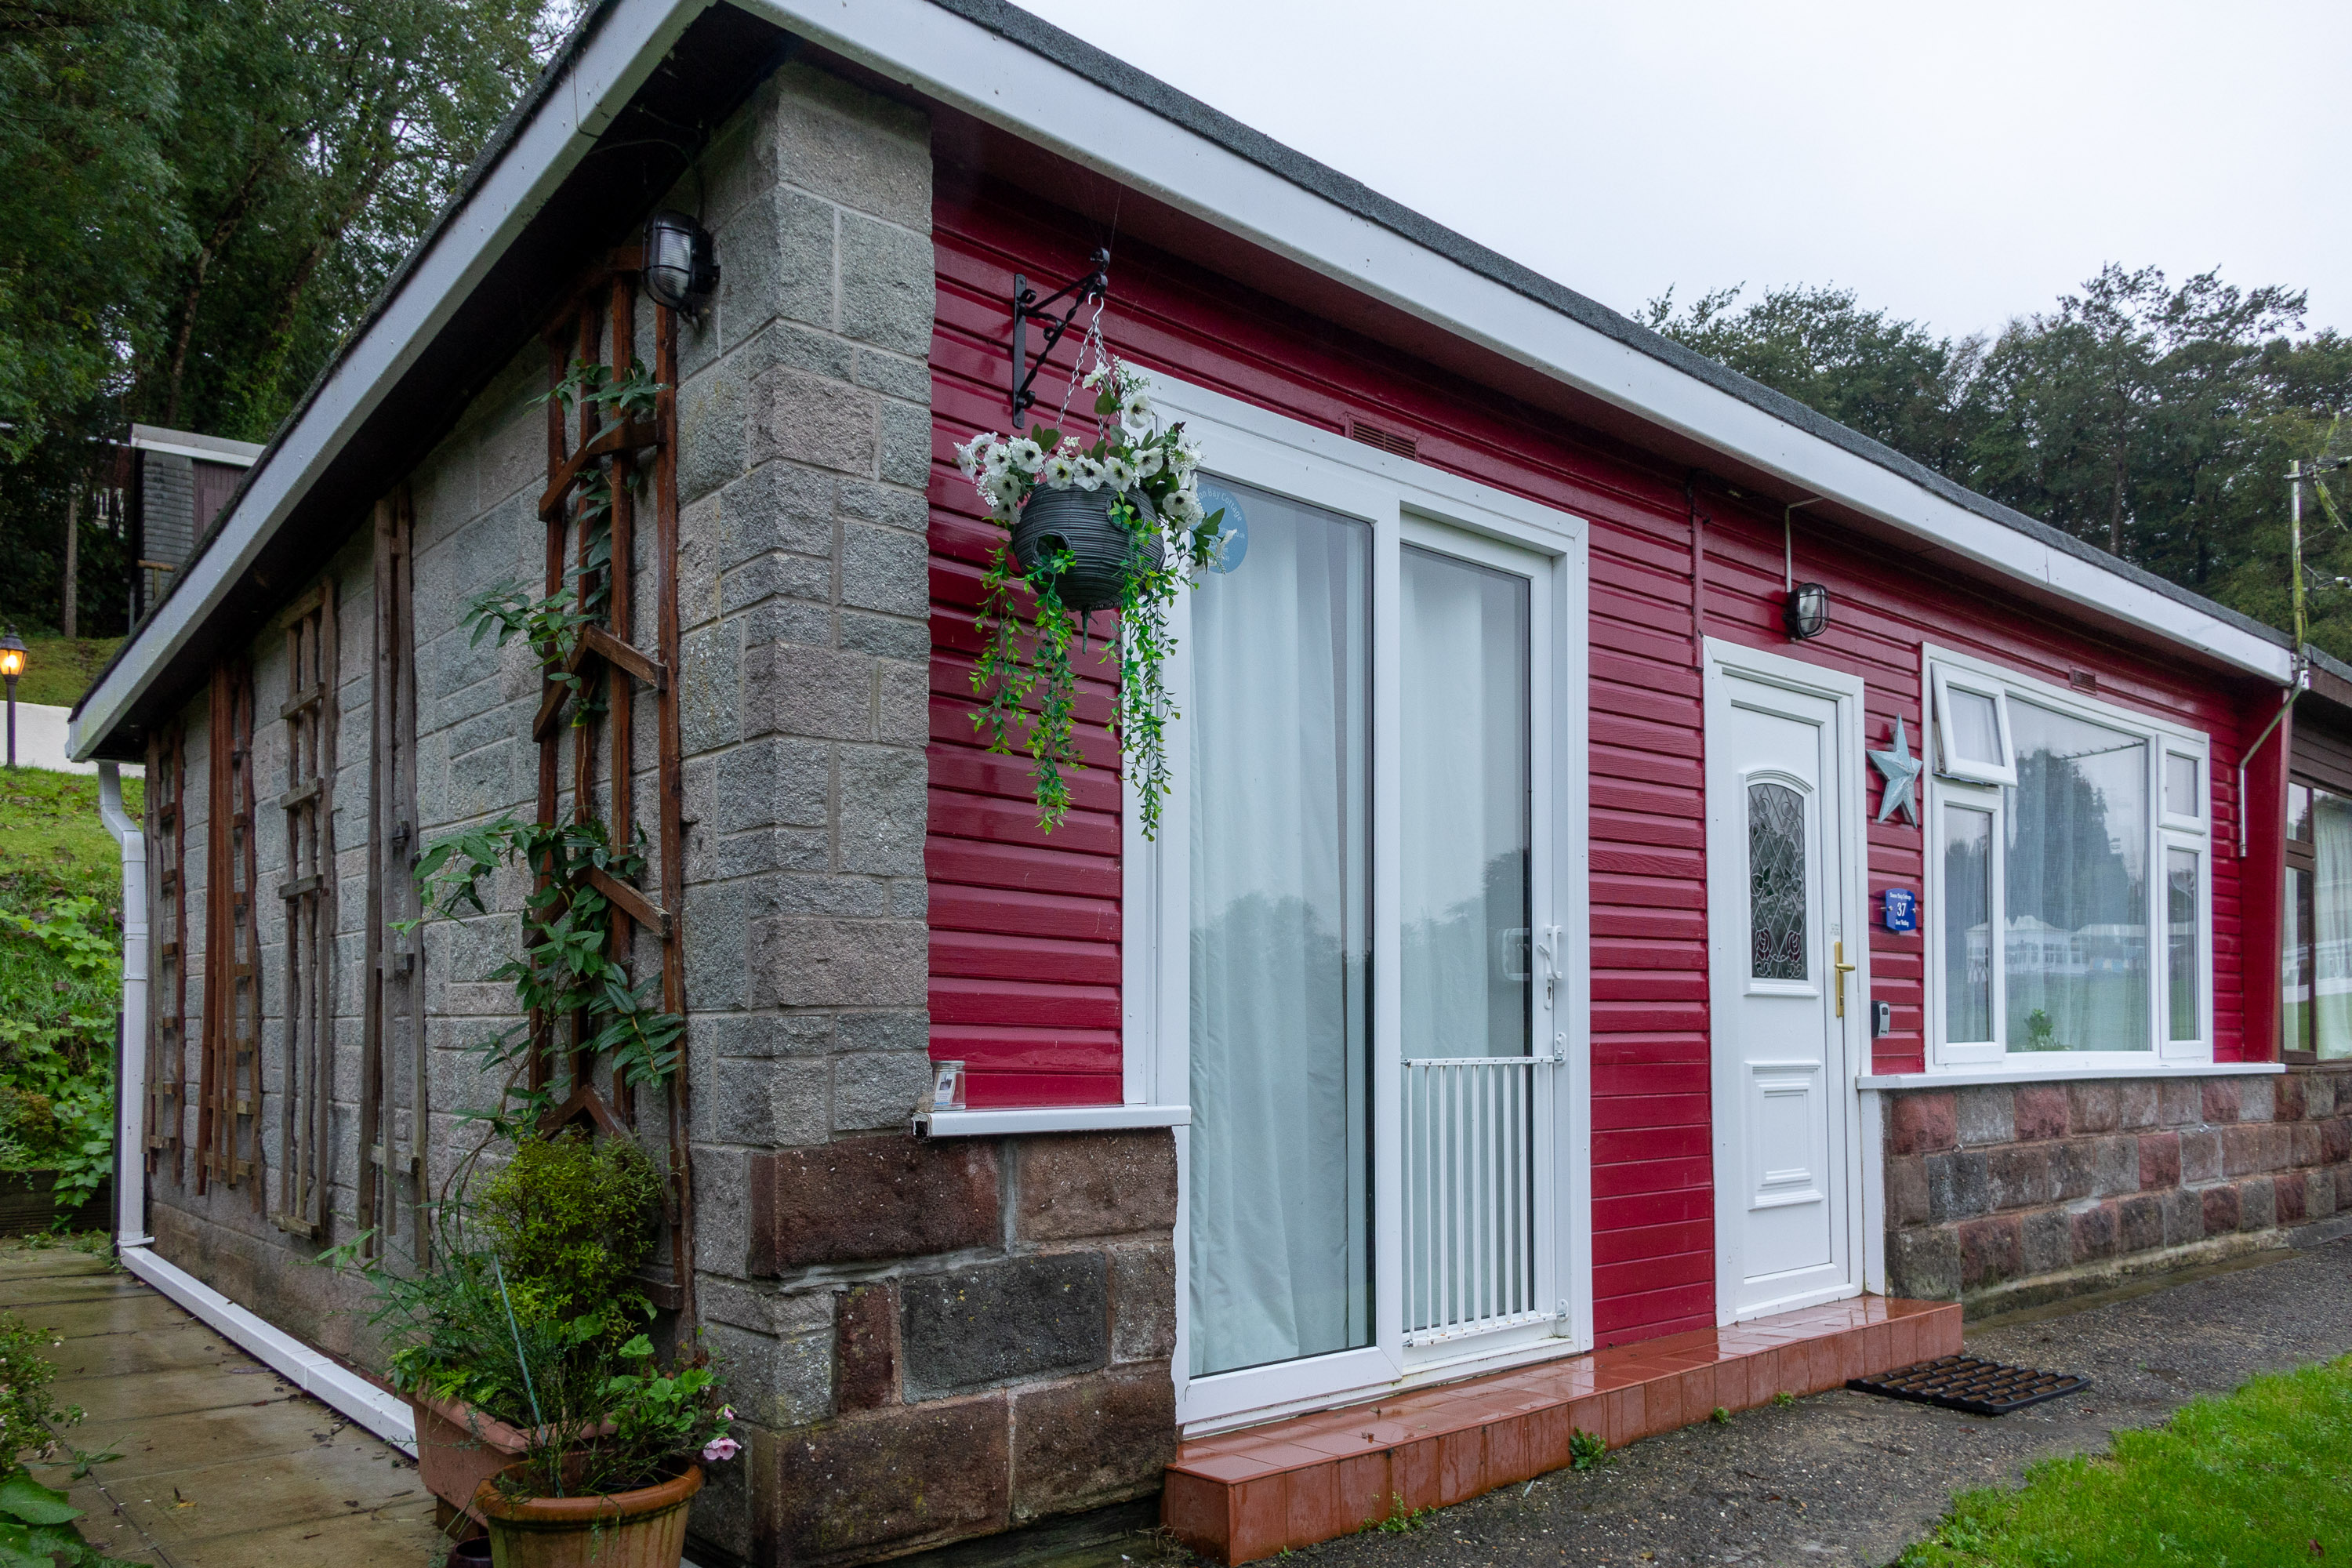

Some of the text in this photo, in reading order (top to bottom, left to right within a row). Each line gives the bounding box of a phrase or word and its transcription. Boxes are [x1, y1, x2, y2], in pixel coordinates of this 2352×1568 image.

[1207, 488, 1220, 499] Bay
[1221, 492, 1243, 521] Cottage
[1897, 902, 1906, 916] 37
